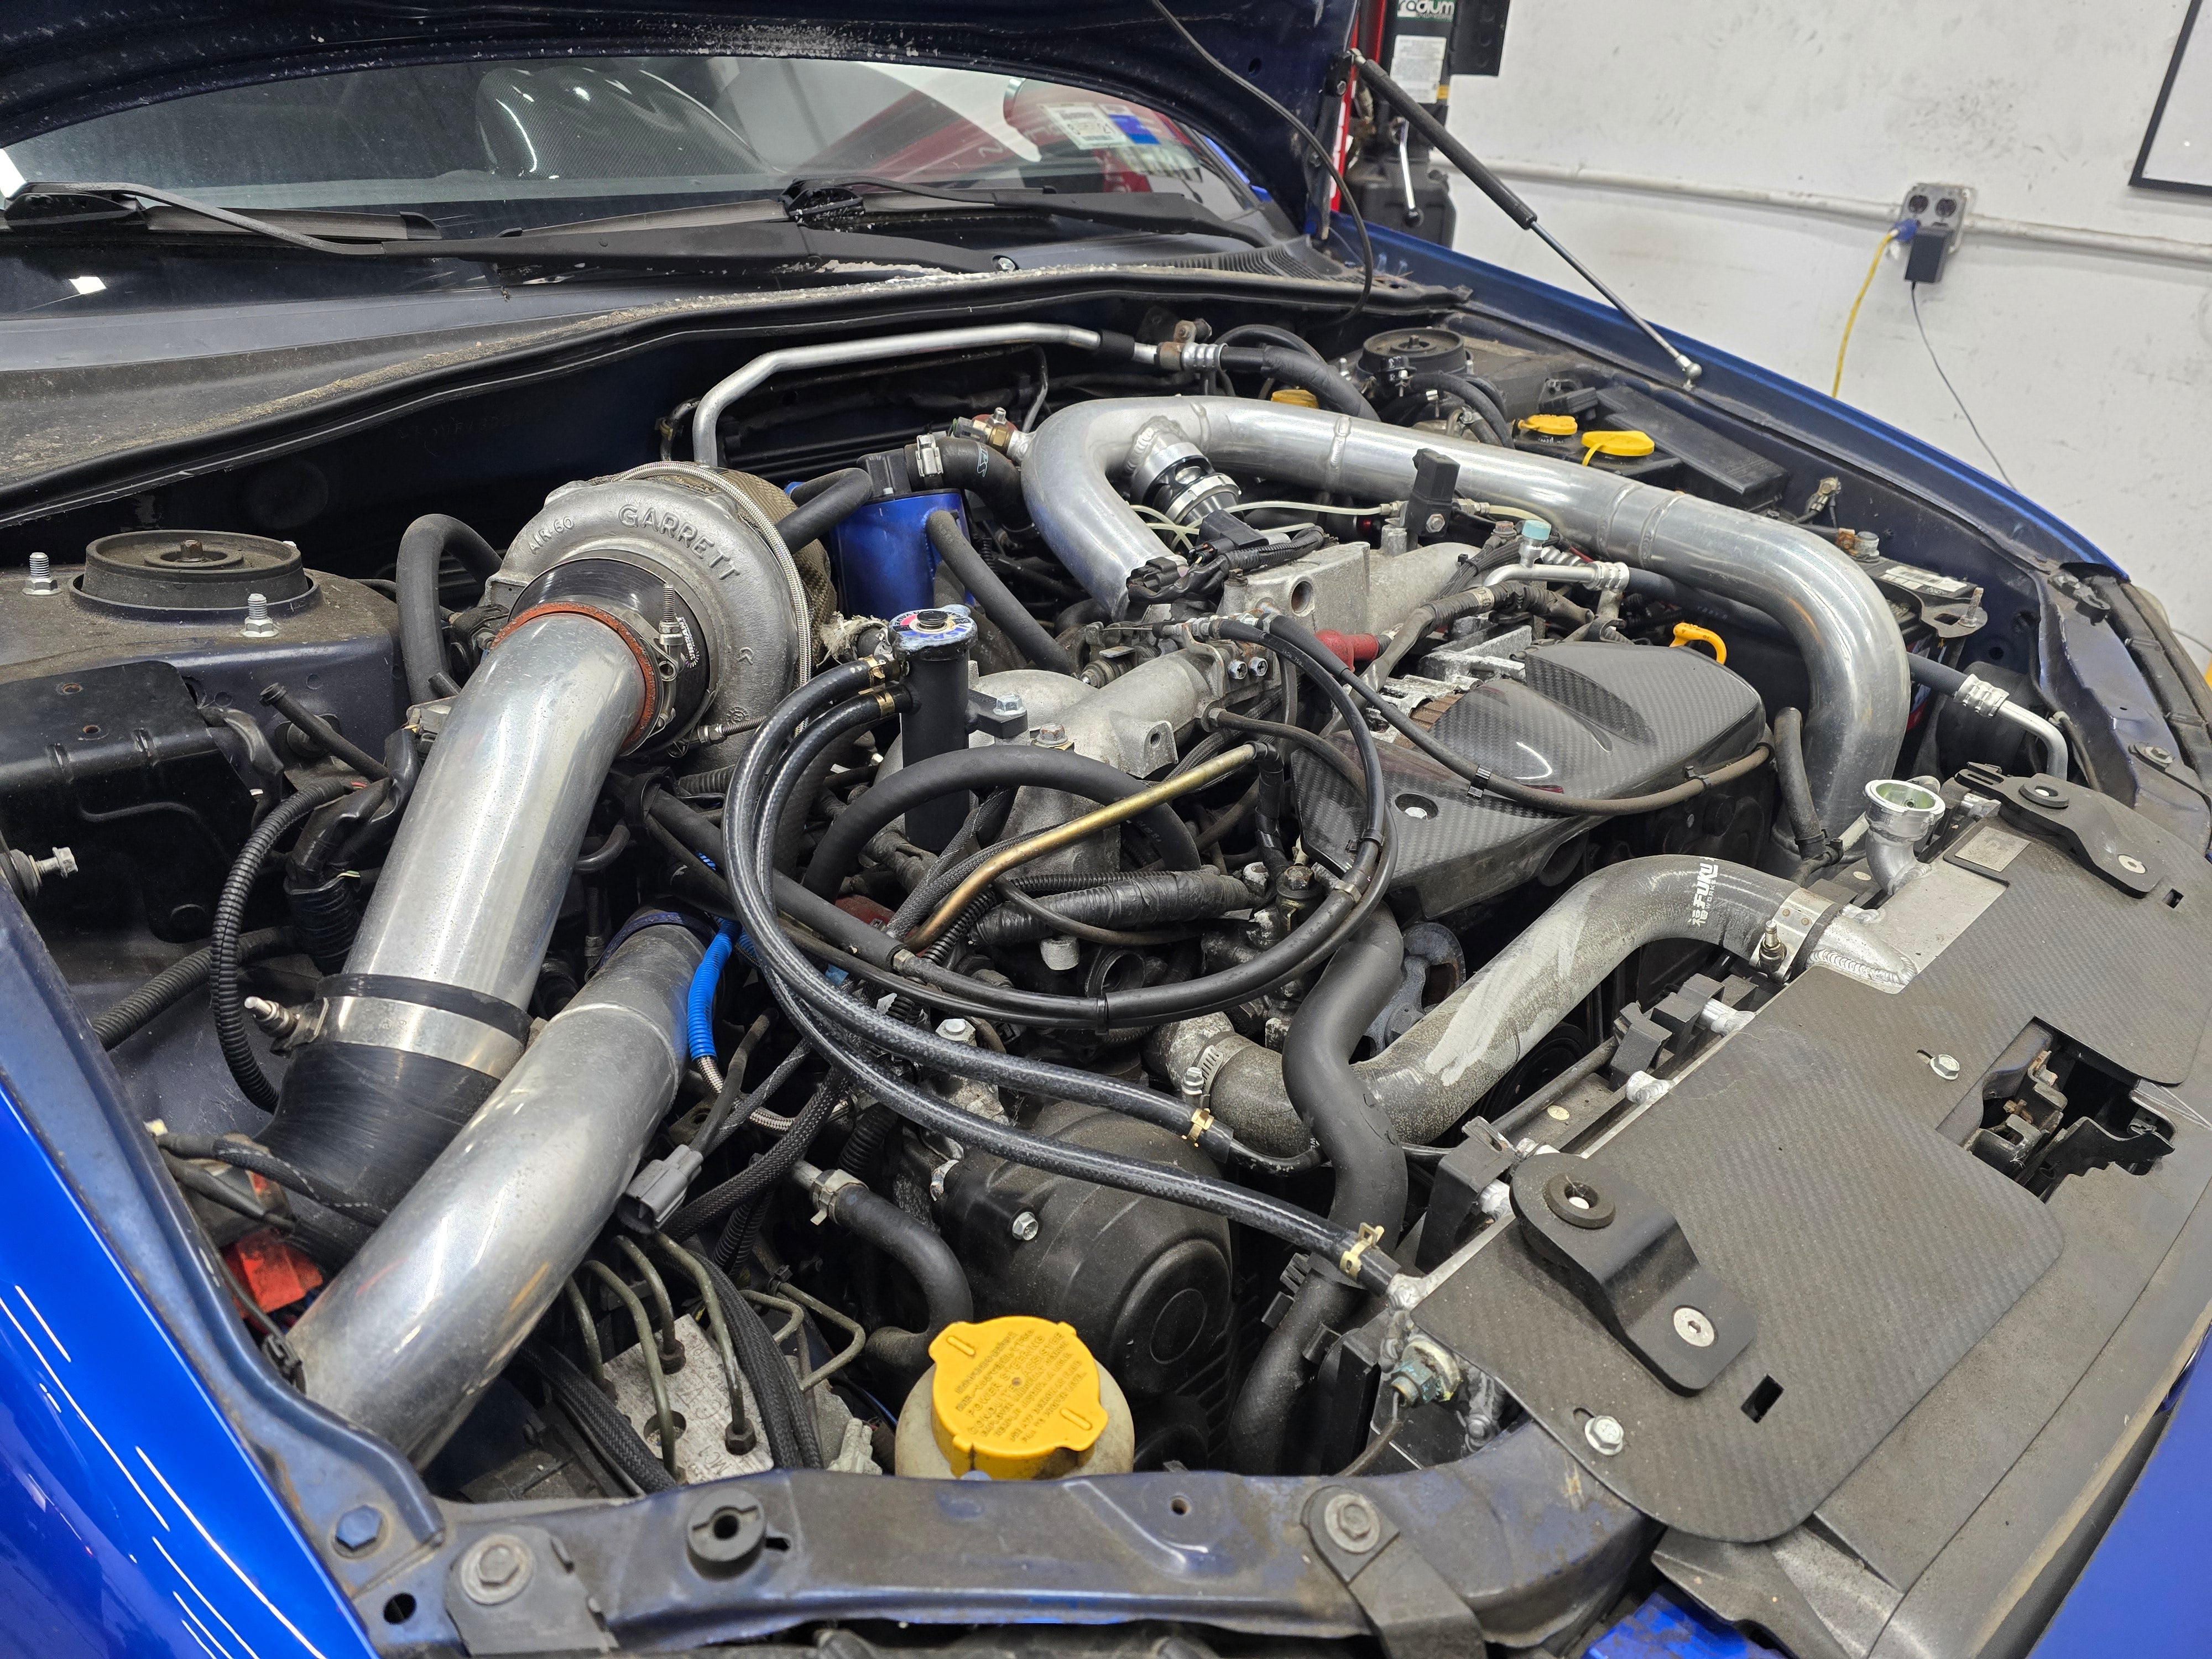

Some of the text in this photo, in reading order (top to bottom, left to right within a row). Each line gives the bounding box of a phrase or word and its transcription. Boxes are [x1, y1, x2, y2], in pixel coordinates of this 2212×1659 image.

[618, 504, 740, 580] GARRETT
[675, 616, 696, 660] VIBRANT
[1693, 863, 1718, 910] FUKU
[1705, 879, 1716, 909] WORKS
[1687, 909, 1708, 927] 福
[967, 1381, 1002, 1418] POWER
[1000, 1334, 1045, 1382] STEERING
[967, 1383, 1017, 1436] CONDUITE
